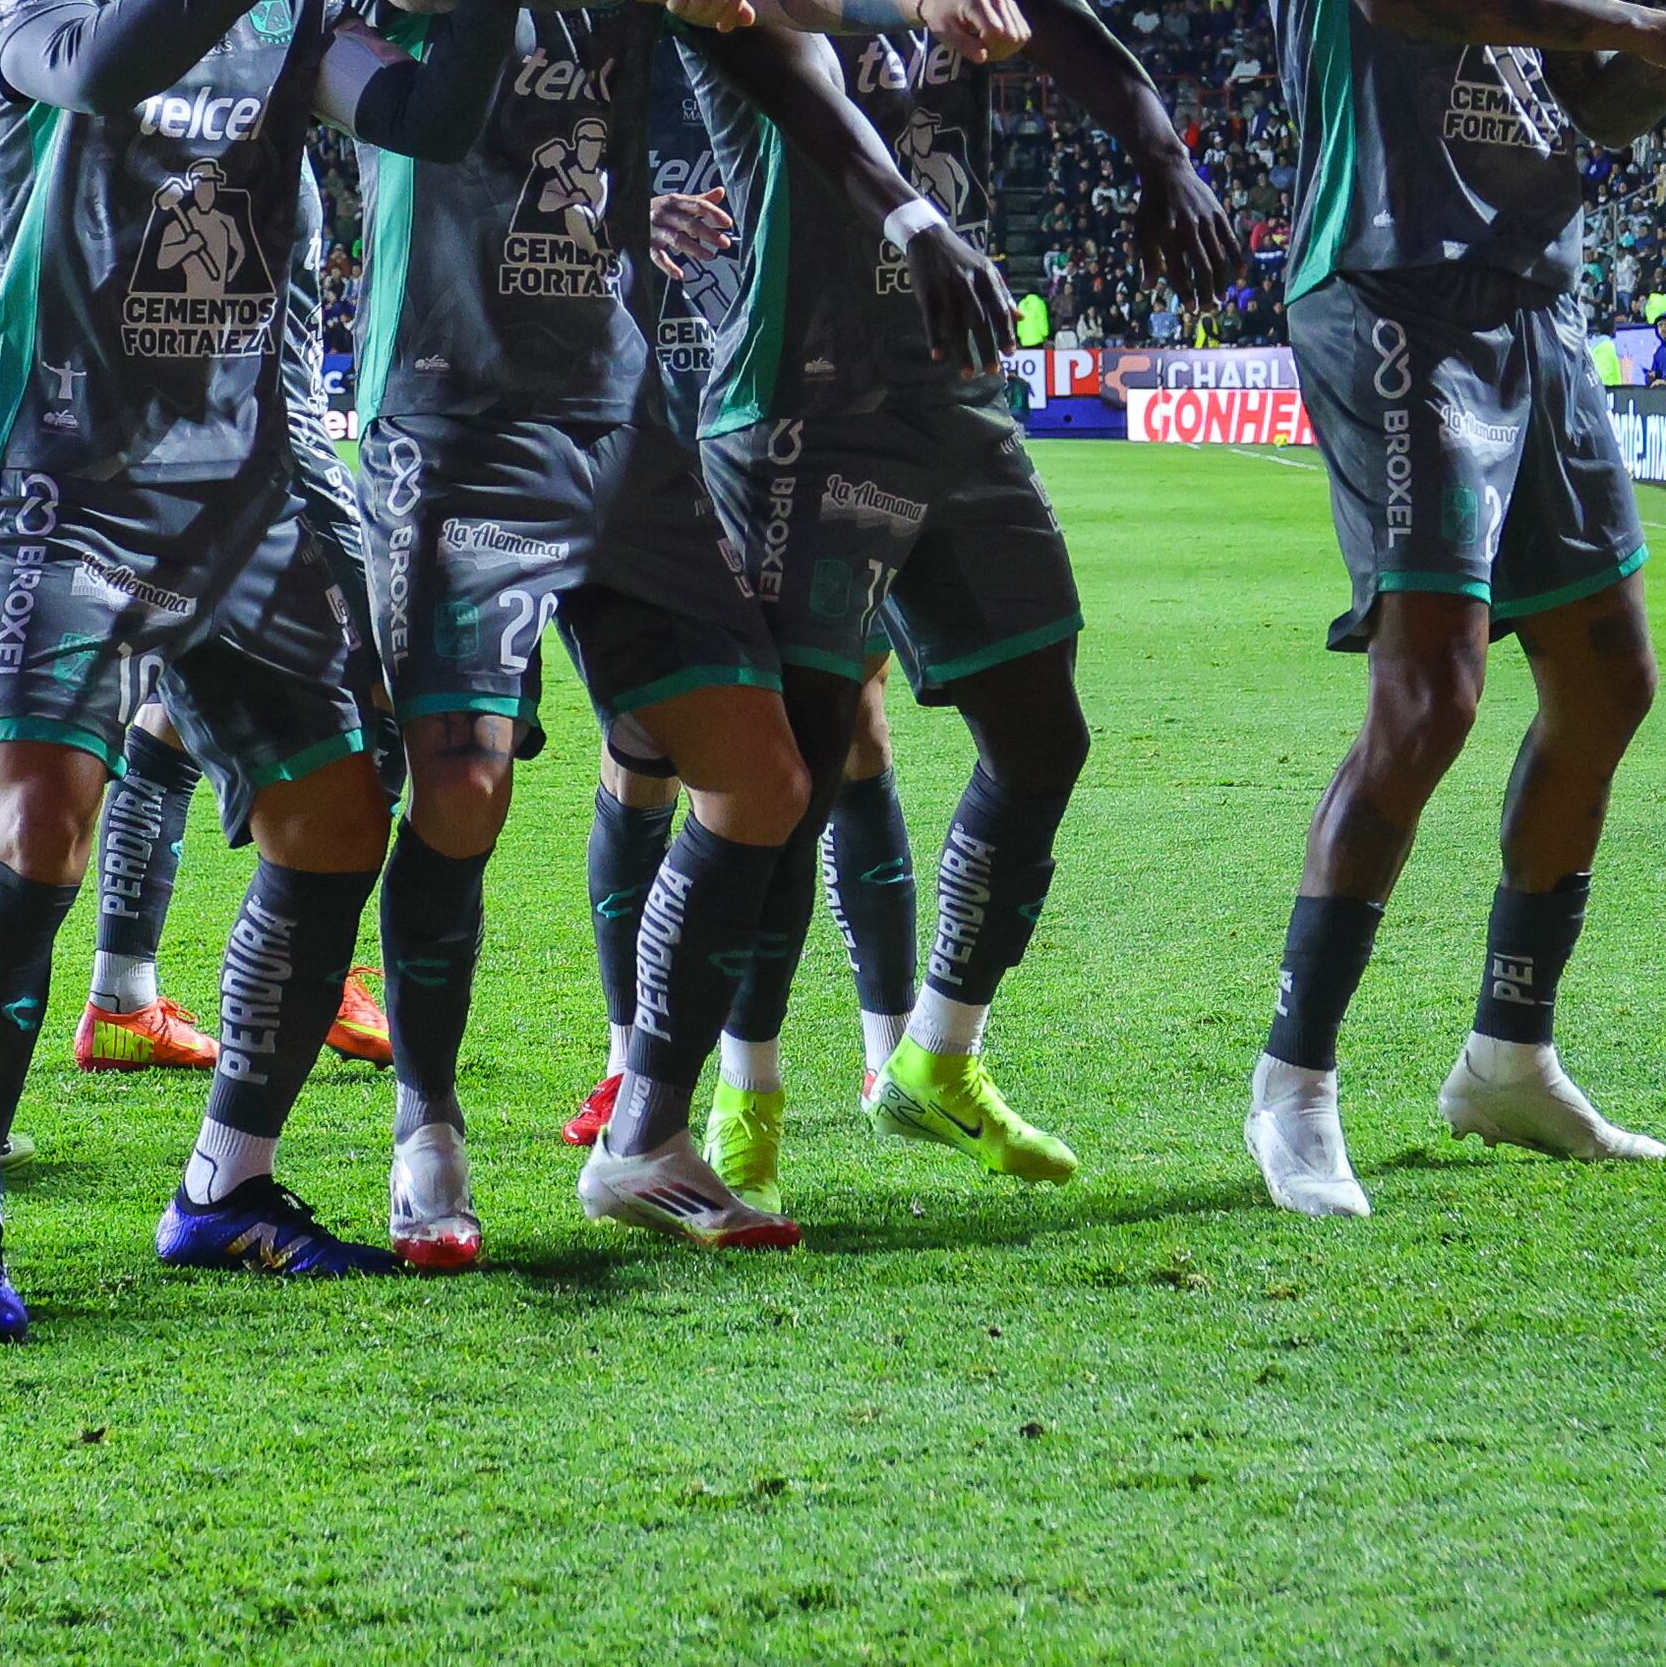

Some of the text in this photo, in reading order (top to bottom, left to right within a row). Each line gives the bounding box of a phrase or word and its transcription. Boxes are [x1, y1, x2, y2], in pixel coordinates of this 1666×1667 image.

[124, 298, 276, 325] CEMENTOS
[124, 327, 274, 355] FORTALEZA
[443, 519, 561, 558] La Alemana
[853, 481, 924, 523] Alemana
[1382, 409, 1413, 549] BROXEL
[389, 525, 414, 676] BROXEL
[102, 774, 168, 920] PERDURA
[929, 829, 997, 986] PERDURA
[220, 899, 300, 1085] PERDURA
[634, 862, 693, 1043] PERDURA
